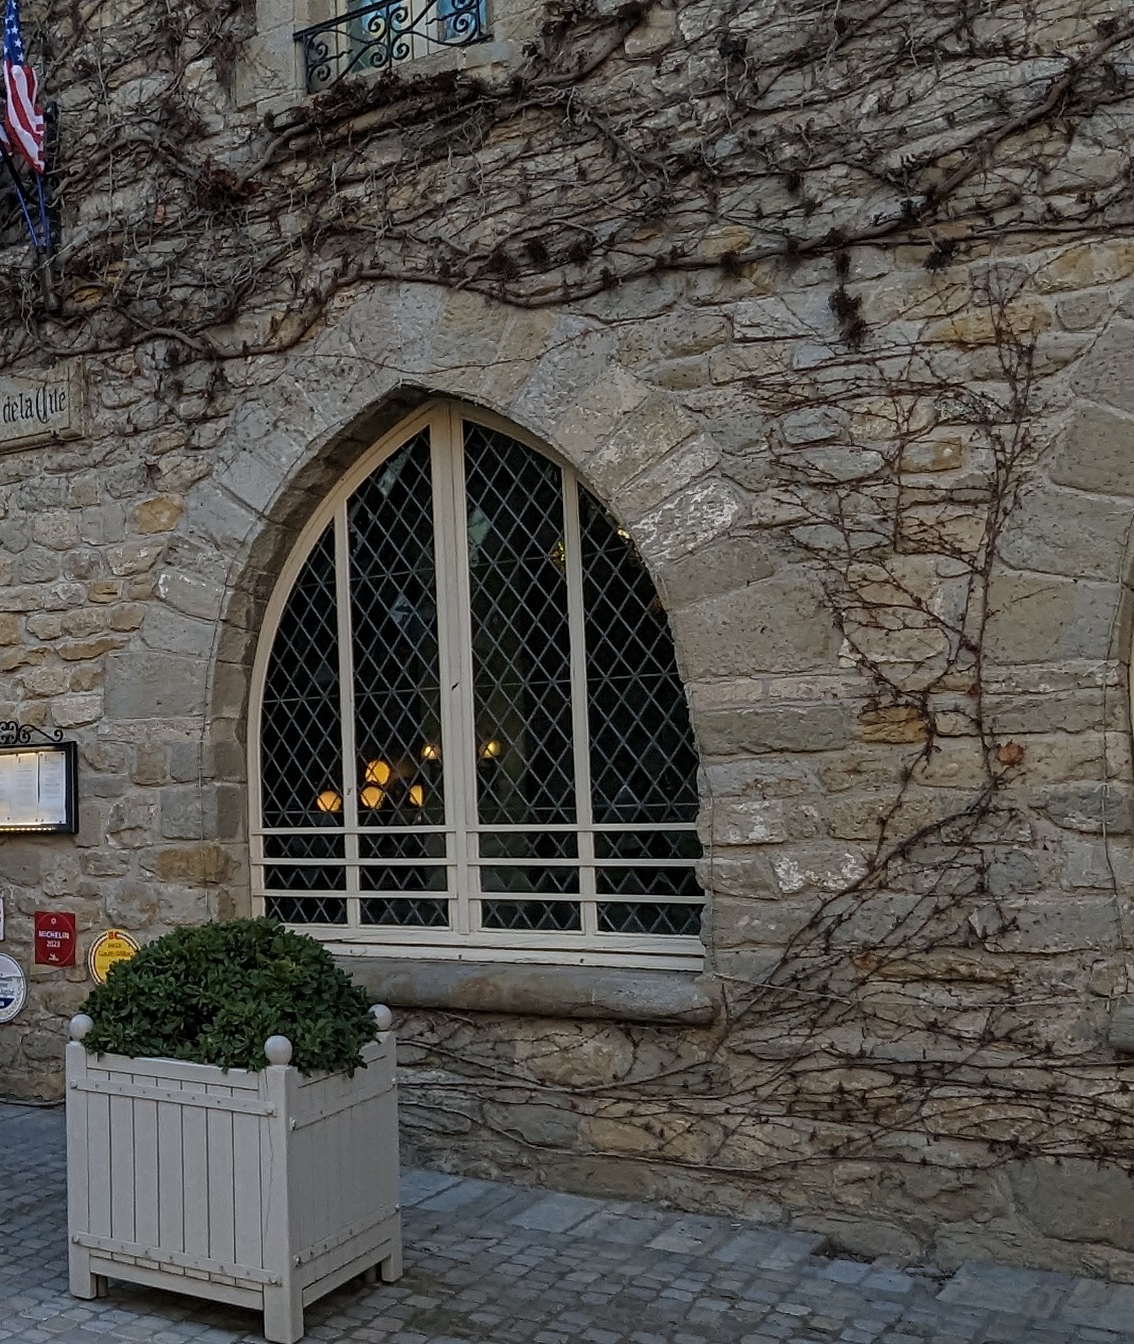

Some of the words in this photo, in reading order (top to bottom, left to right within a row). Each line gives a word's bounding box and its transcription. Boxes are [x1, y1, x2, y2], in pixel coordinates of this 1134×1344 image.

[3, 395, 18, 424] de
[20, 393, 33, 420] la
[35, 383, 66, 424] Cité
